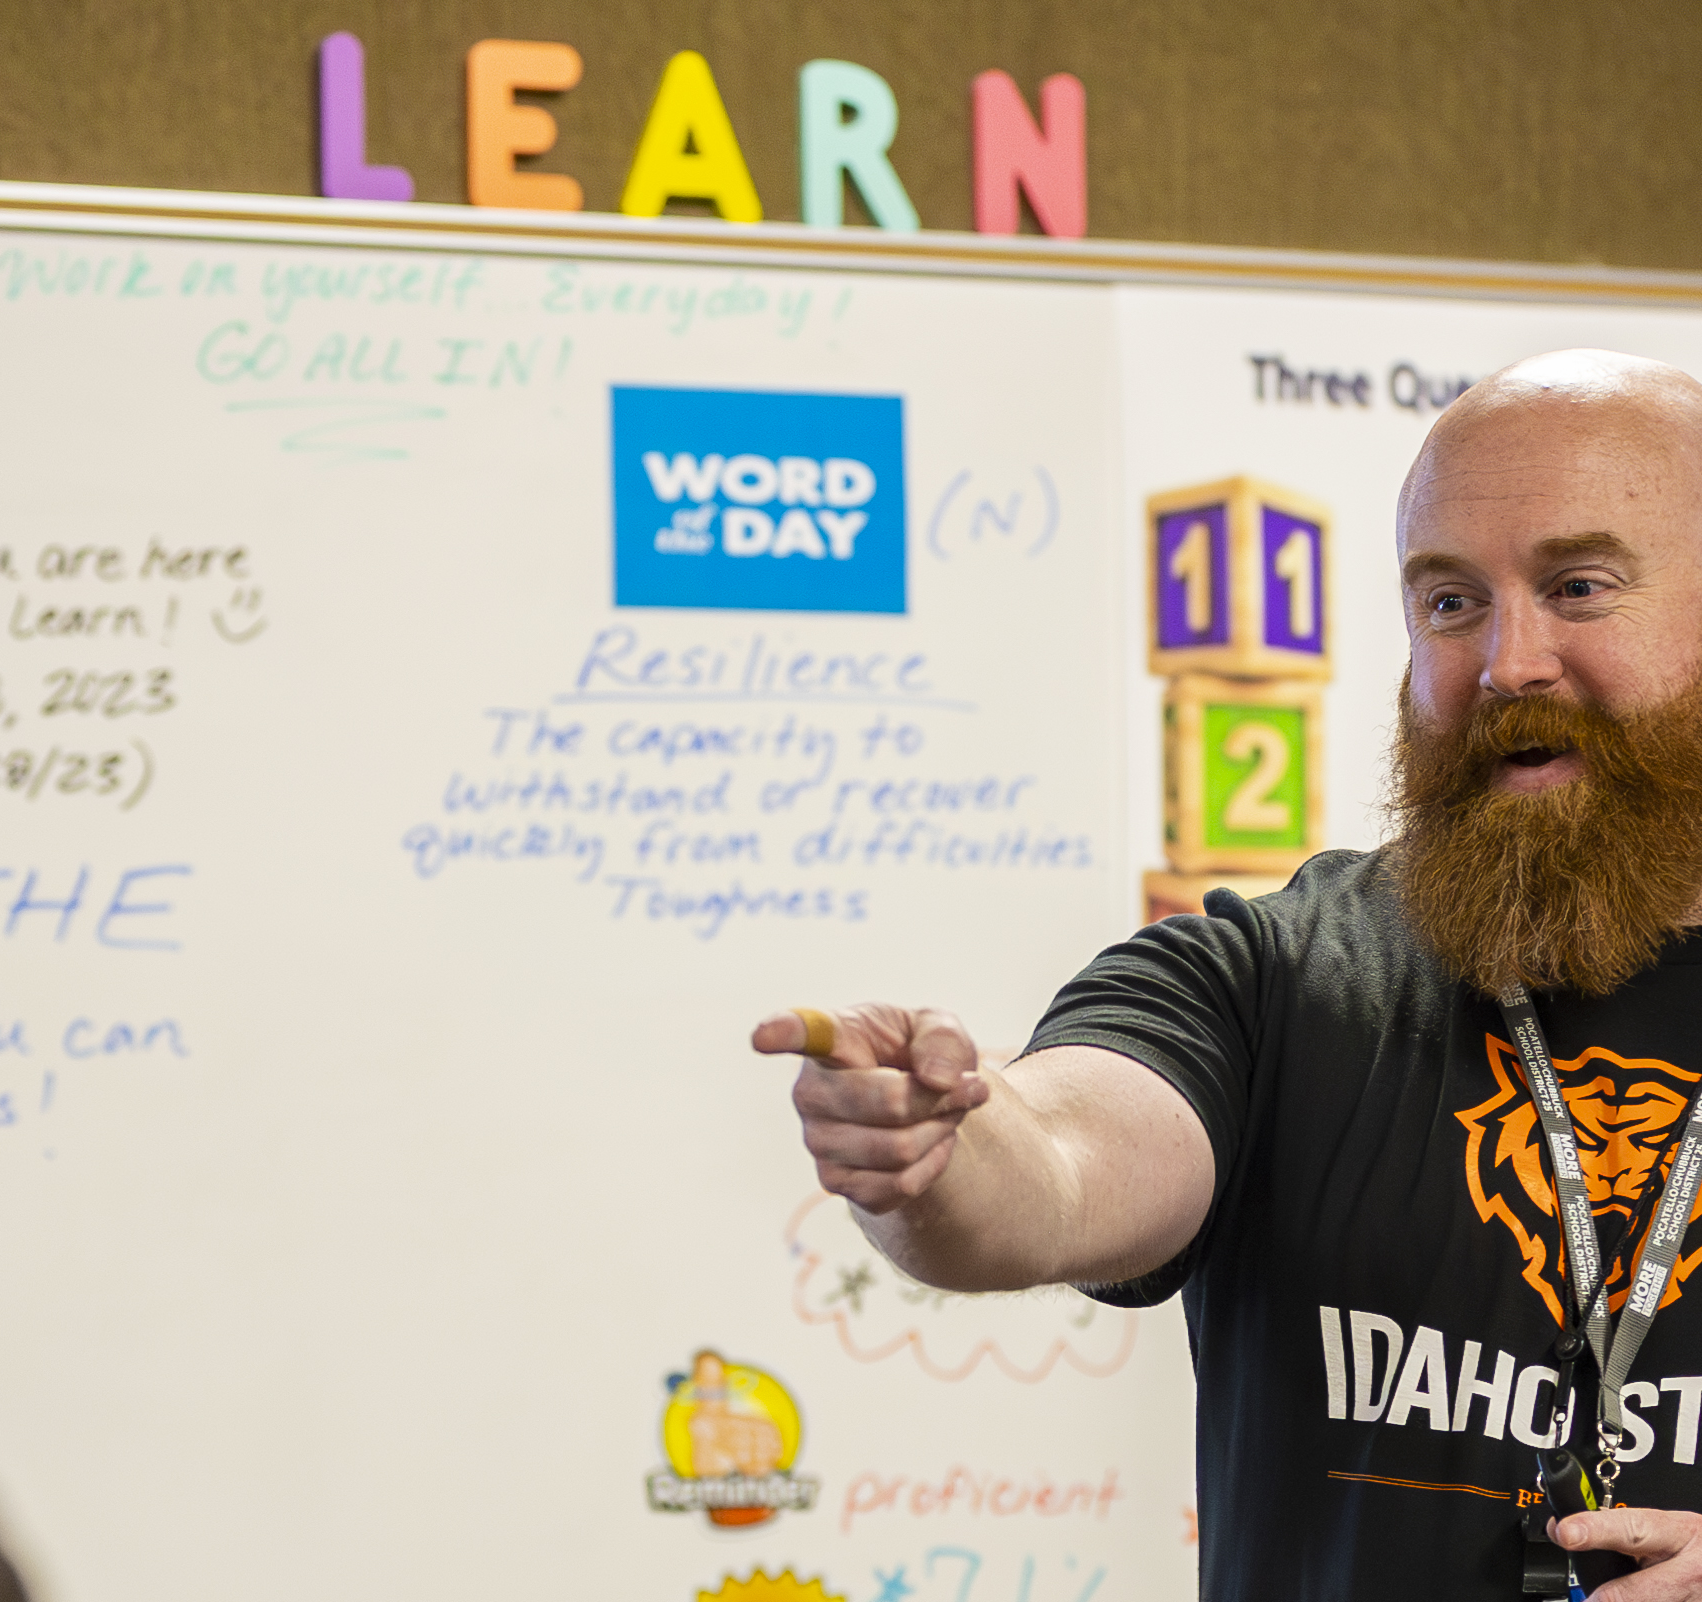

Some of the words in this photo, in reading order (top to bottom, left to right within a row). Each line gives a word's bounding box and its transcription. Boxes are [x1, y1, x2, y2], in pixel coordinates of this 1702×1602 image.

[319, 32, 1087, 239] LEARN
[180, 259, 237, 297] on
[196, 319, 292, 385] GO
[303, 331, 409, 383] ALL
[1248, 354, 1373, 408] Three
[640, 450, 877, 508] WORD
[36, 540, 127, 582] are
[139, 535, 252, 582] here
[720, 506, 870, 561] DAY
[1171, 519, 1212, 633] 1
[1273, 528, 1314, 640] 1
[575, 623, 936, 694] Resilience
[39, 667, 180, 722] 2023
[483, 706, 586, 756] The
[606, 714, 838, 790] capacity
[859, 712, 923, 761] to
[1223, 722, 1291, 832] 2
[442, 769, 733, 815] withstand
[759, 778, 805, 814] or
[829, 773, 1039, 815] recover
[634, 818, 763, 867] from
[793, 818, 1095, 869] difficulties
[603, 876, 871, 941] Toughness
[62, 1015, 192, 1059] can
[1514, 1026, 1535, 1062] SCHOOL
[1528, 1061, 1549, 1102] DISTRICT
[1558, 1132, 1582, 1181] MORE
[1652, 1135, 1698, 1247] POCATELLO/CHUBBUCK
[1665, 1199, 1690, 1242] SCHOOL
[1681, 1154, 1702, 1201] DISTRICT
[1566, 1202, 1584, 1248] SCHOOL
[1628, 1259, 1658, 1314] MORE
[1641, 1264, 1668, 1318] TOGETHER
[1319, 1305, 1575, 1450] IDAHO
[837, 1463, 1128, 1534] proficient
